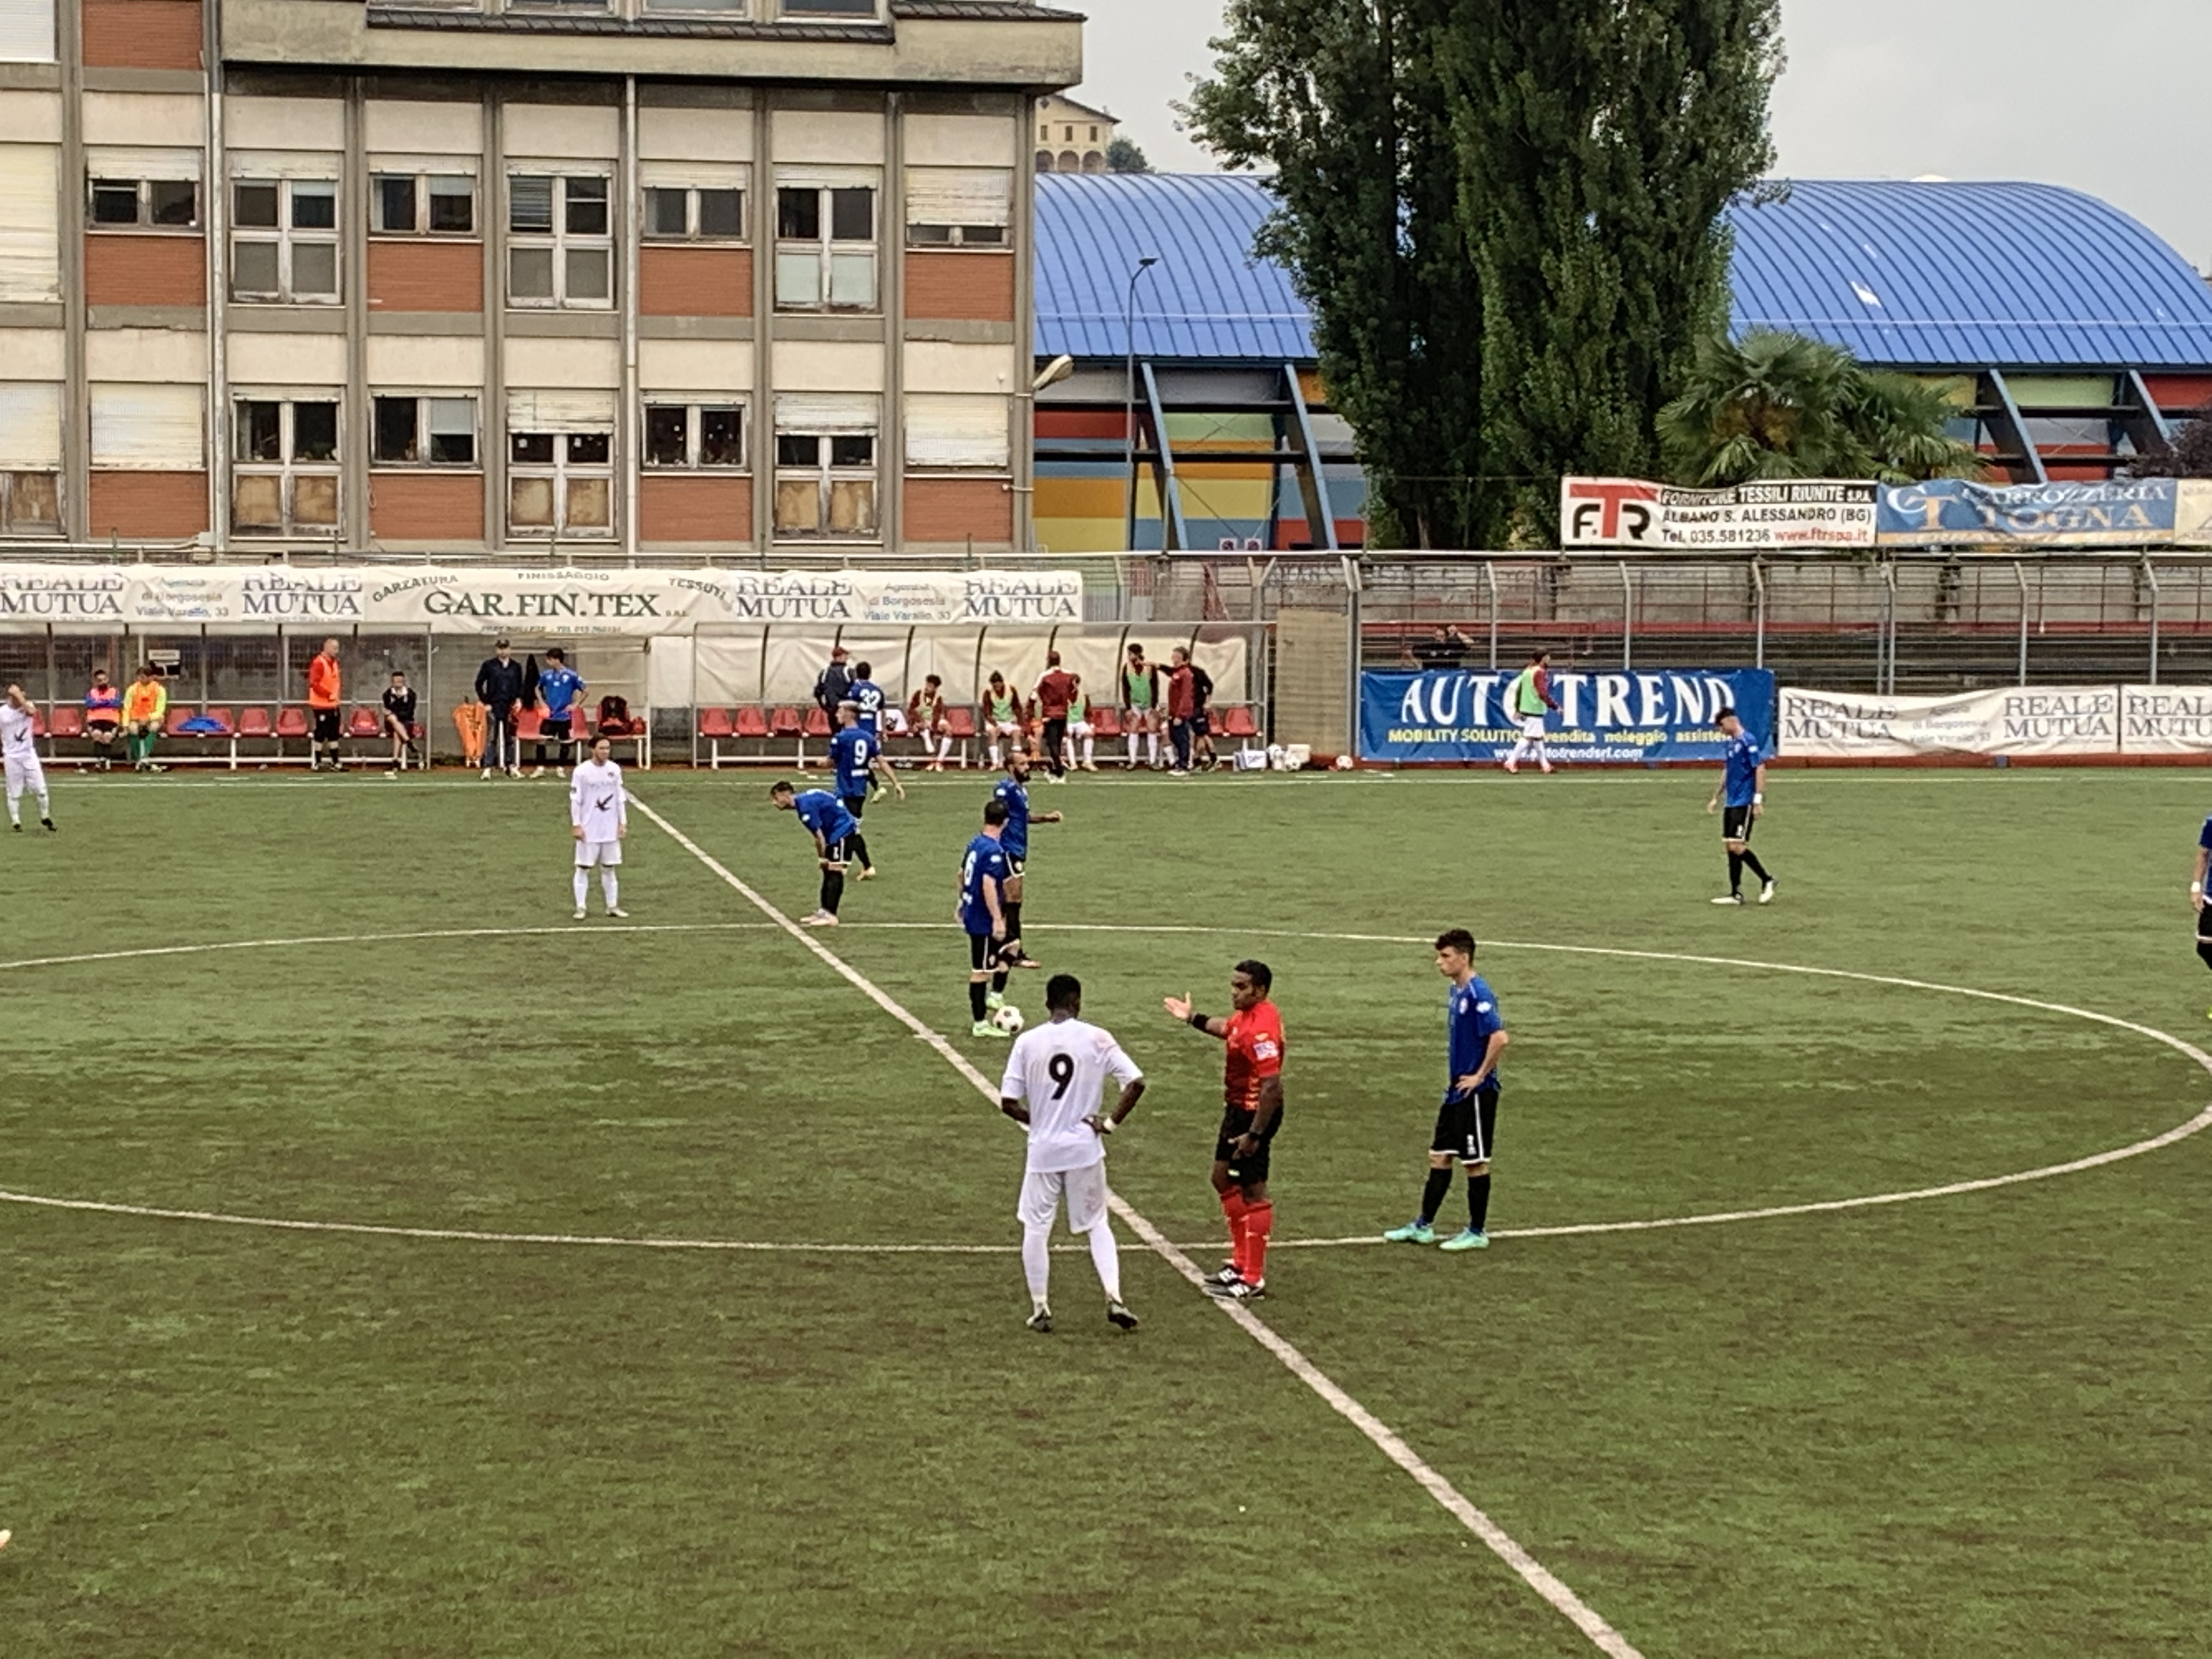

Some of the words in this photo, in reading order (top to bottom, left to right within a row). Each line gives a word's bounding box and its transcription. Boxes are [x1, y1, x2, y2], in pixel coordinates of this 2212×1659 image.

[1739, 486, 1789, 503] TESSILI
[1791, 485, 1846, 502] RIUNITE
[1662, 510, 1720, 523] ALBANO
[1724, 510, 1737, 522] S.
[1741, 507, 1836, 522] ALESSANDRO
[1841, 507, 1872, 524] (BG)
[1774, 527, 1868, 543] www.ftrspa.it
[0, 573, 123, 591] REALE
[241, 573, 362, 592] REALE
[372, 575, 459, 602] GARZATURA
[737, 576, 853, 595] REALE
[963, 578, 1079, 595] REALE
[0, 592, 123, 613] MUTUA
[242, 593, 362, 614] MUTUA
[737, 596, 852, 618] MUTUA
[963, 597, 1076, 617] MUTUA
[859, 687, 881, 712] 32
[1785, 696, 1897, 720] REALE
[2004, 695, 2114, 716] REALE
[2127, 695, 2212, 716] REAL
[1387, 729, 1459, 743] MOBILITY
[1461, 728, 1522, 743] SOLUTIO
[1544, 729, 1596, 743] vendita
[1604, 729, 1668, 746] noleggio
[1784, 719, 1894, 739] MUTUA
[2004, 716, 2112, 738] MUTUA
[2127, 718, 2212, 738] MUTU
[854, 738, 868, 766] 9
[964, 850, 977, 887] 6
[1048, 1052, 1075, 1101] 9
